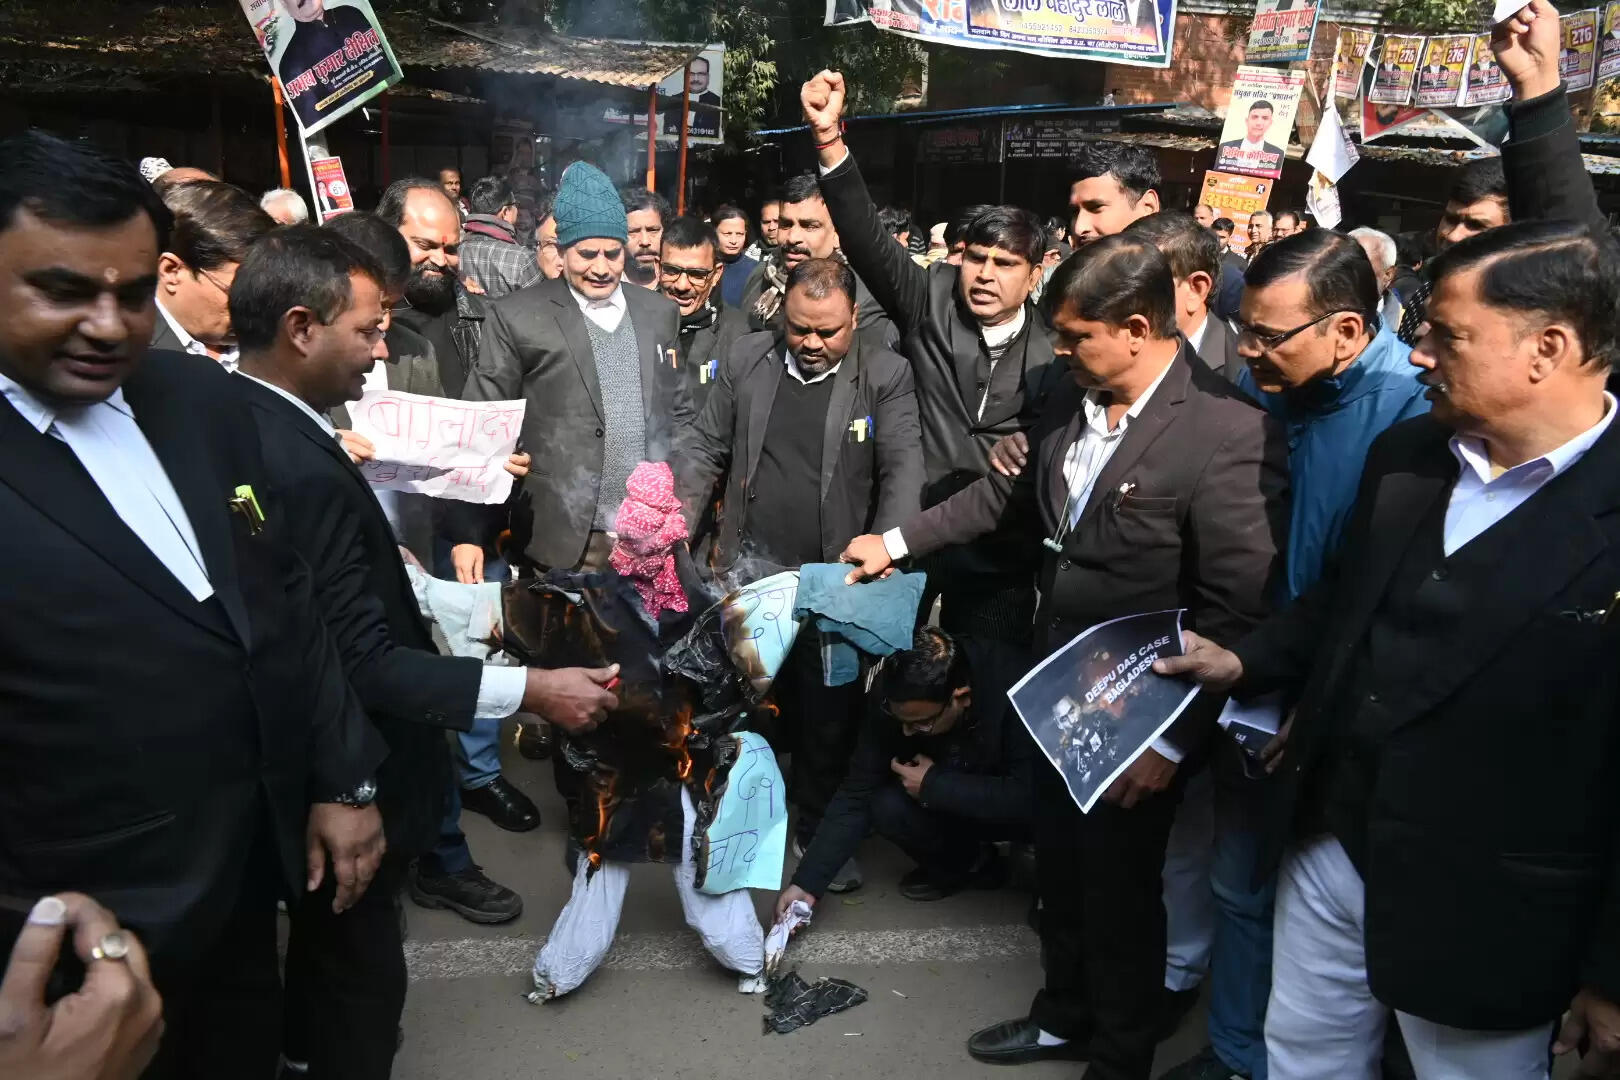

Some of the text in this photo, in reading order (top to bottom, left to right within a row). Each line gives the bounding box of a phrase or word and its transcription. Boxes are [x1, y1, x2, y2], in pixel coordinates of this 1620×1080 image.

[1571, 27, 1592, 45] 276
[314, 49, 346, 84] कुमार
[344, 28, 381, 62] दीक्षित
[1400, 48, 1415, 62] 276
[1447, 48, 1464, 63] 276
[1085, 635, 1171, 703] DEEPU DAS CASE
[1106, 651, 1160, 704] BAGLADESH
